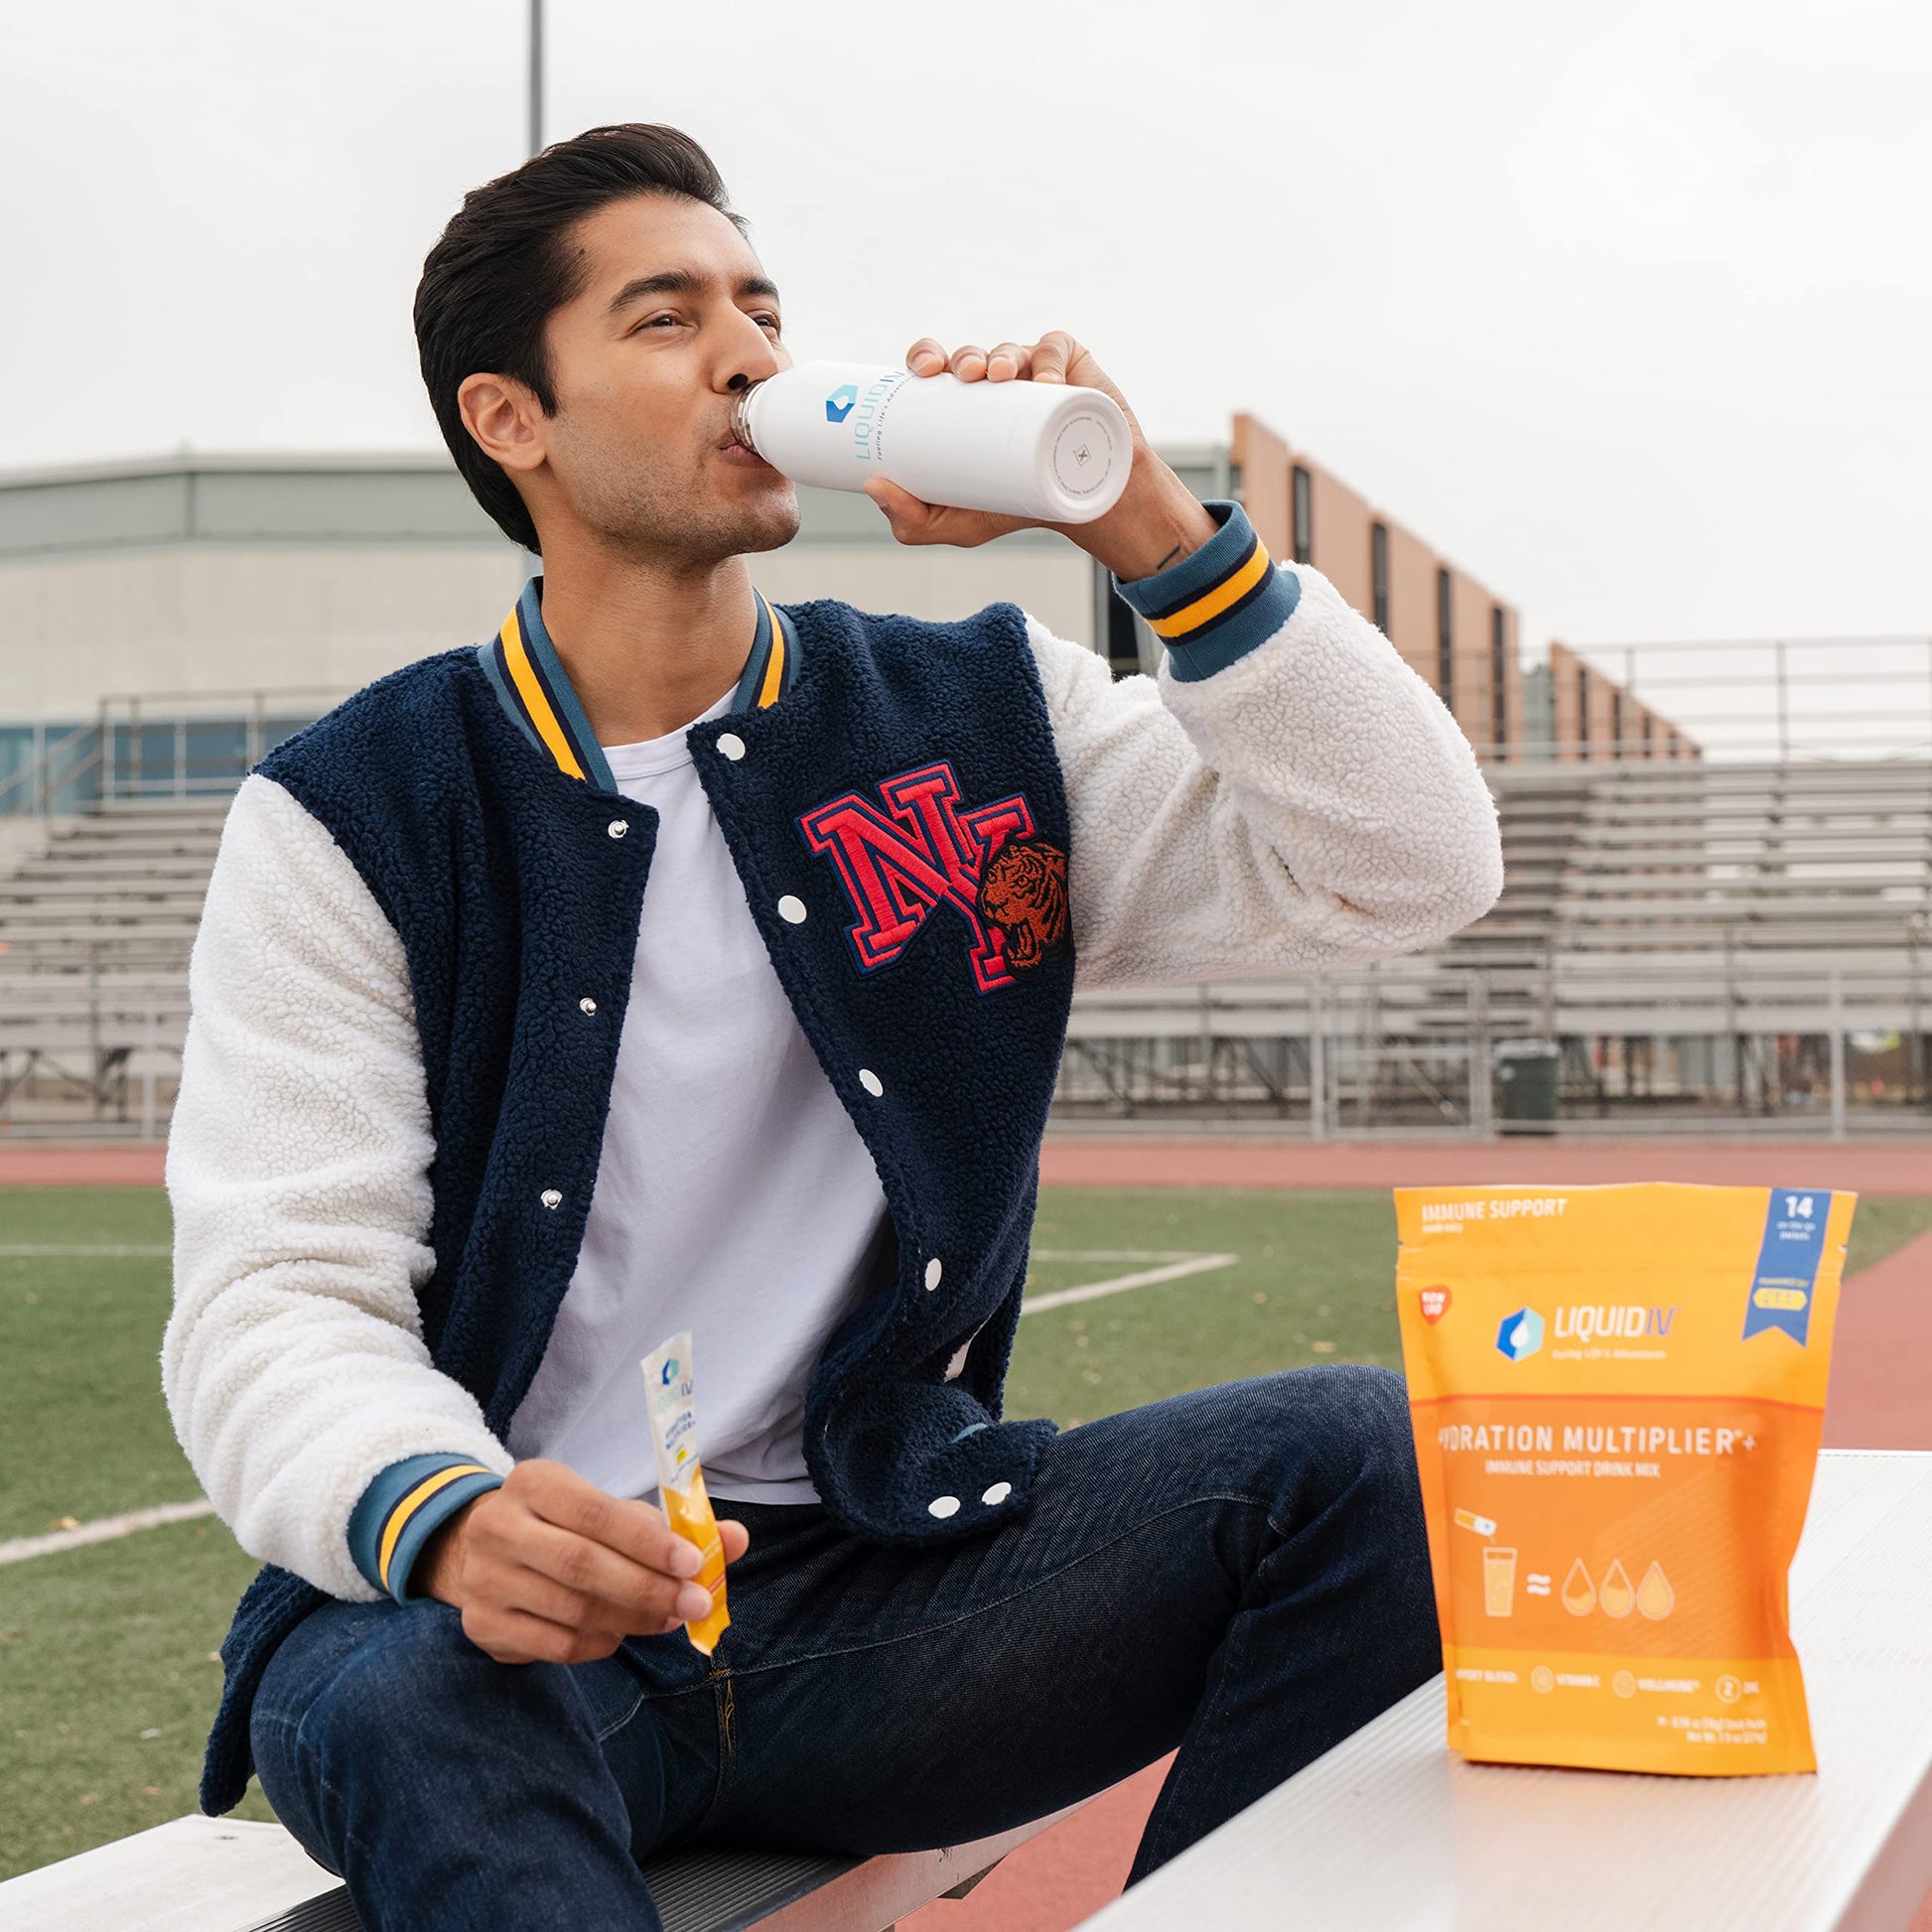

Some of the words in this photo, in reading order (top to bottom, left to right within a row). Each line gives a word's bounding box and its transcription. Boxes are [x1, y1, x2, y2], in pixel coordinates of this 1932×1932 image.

[1422, 1201, 1486, 1222] IMMUNE
[1489, 1197, 1568, 1219] SUPPORT
[1785, 1195, 1814, 1218] 14
[1535, 1459, 1591, 1476] SUPPORT
[1592, 1460, 1633, 1477] DRINK
[1634, 1461, 1661, 1477] MIX
